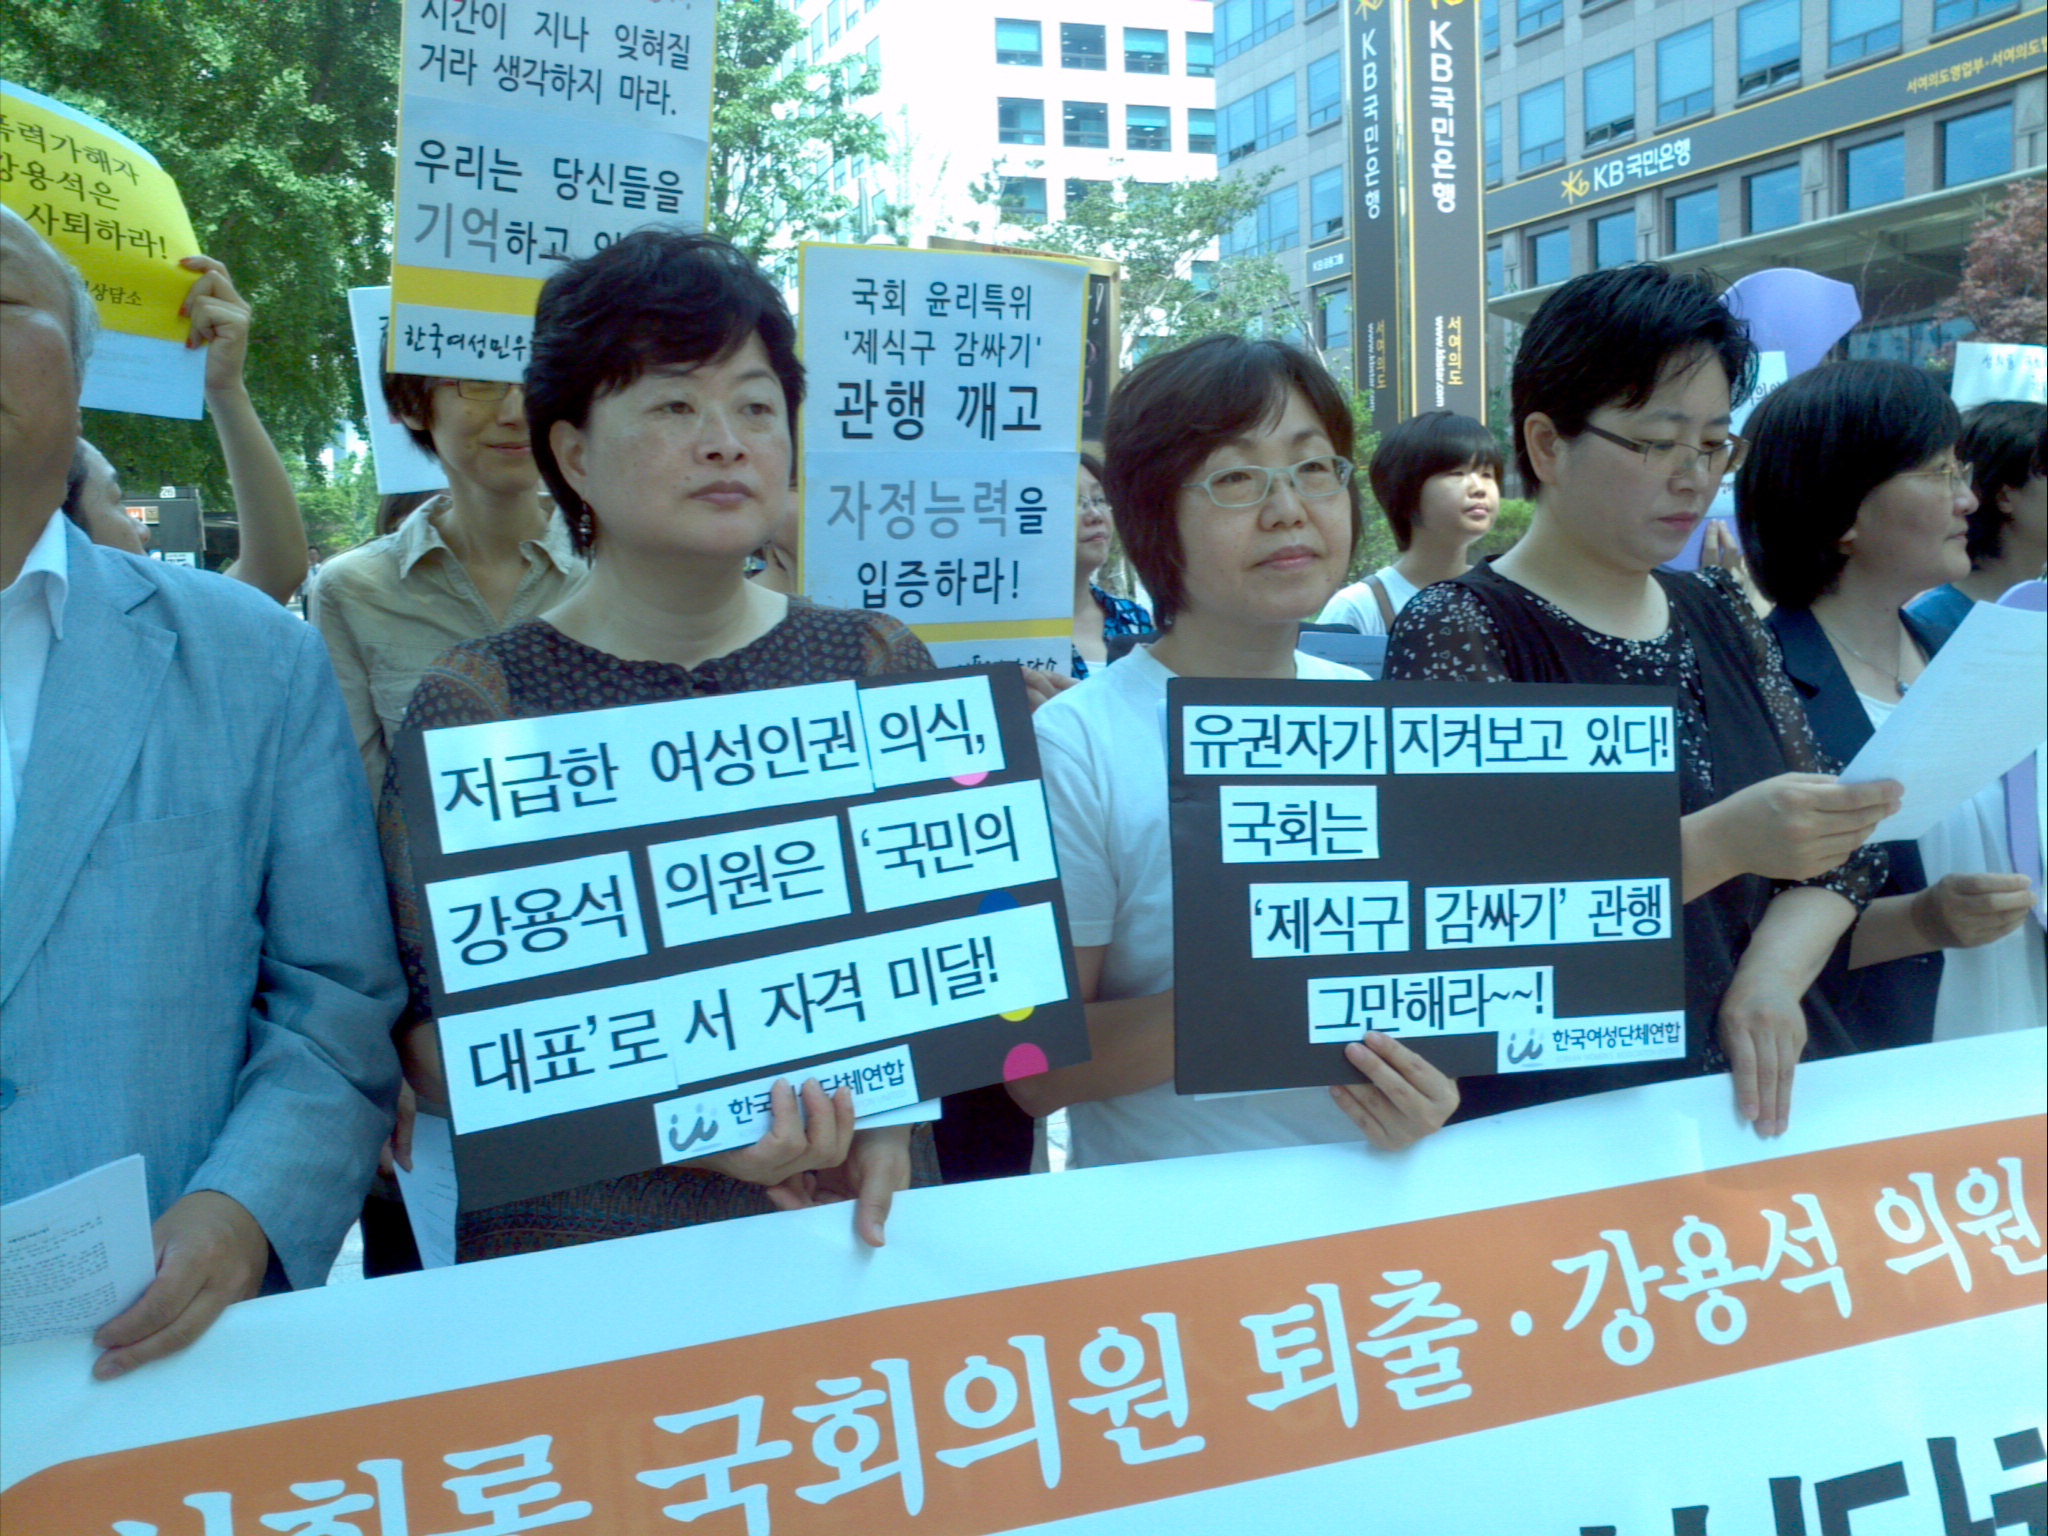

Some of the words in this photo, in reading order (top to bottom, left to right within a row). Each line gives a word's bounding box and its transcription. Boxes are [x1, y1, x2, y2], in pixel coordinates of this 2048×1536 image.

[420, 0, 506, 40] 시간이
[534, 11, 590, 53] 지나
[614, 24, 691, 71] 잊혀질
[418, 43, 478, 86] 거라
[493, 53, 602, 105] 생각하지
[618, 74, 677, 116] 마라.
[1429, 19, 1457, 214] KB국민은행
[414, 139, 523, 193] 우리는
[553, 156, 684, 214] 당신들을
[25, 203, 168, 259] 사퇴하라!
[414, 202, 572, 265] 기억하고
[84, 280, 142, 306] 상담소
[851, 278, 906, 317] 국회
[926, 281, 1032, 320] 윤리특위
[404, 322, 531, 361] 한국여성민우
[844, 328, 937, 366] '제식구
[954, 331, 1042, 368] 감싸기'
[833, 379, 926, 441] 관행
[956, 381, 1042, 441] 깨고
[827, 479, 1048, 541] 자정능력을
[857, 557, 1020, 609] 입증하라!
[440, 742, 619, 822] 저급한
[650, 710, 861, 791] 여성인권
[878, 698, 986, 764] 의식,
[1189, 712, 1378, 770] 유권자가
[1399, 712, 1569, 768] 지켜보고
[1586, 714, 1670, 767] 있다!
[1227, 799, 1368, 857] 국회는
[448, 872, 630, 967] 강용석
[664, 838, 825, 918] 의원은
[1588, 883, 1663, 939] 관행
[762, 962, 866, 1036] 자격
[888, 934, 999, 1007] 미달!
[1314, 970, 1546, 1034] 그만해라~~!
[1552, 1021, 1681, 1051] 한국여성단체연합
[727, 1059, 905, 1126] 한국단체연합
[635, 1311, 1206, 1535] 국회의원
[1239, 1268, 1480, 1430] 퇴출
[1551, 1192, 1853, 1366] 강용석
[1874, 1156, 2047, 1294] 의원
